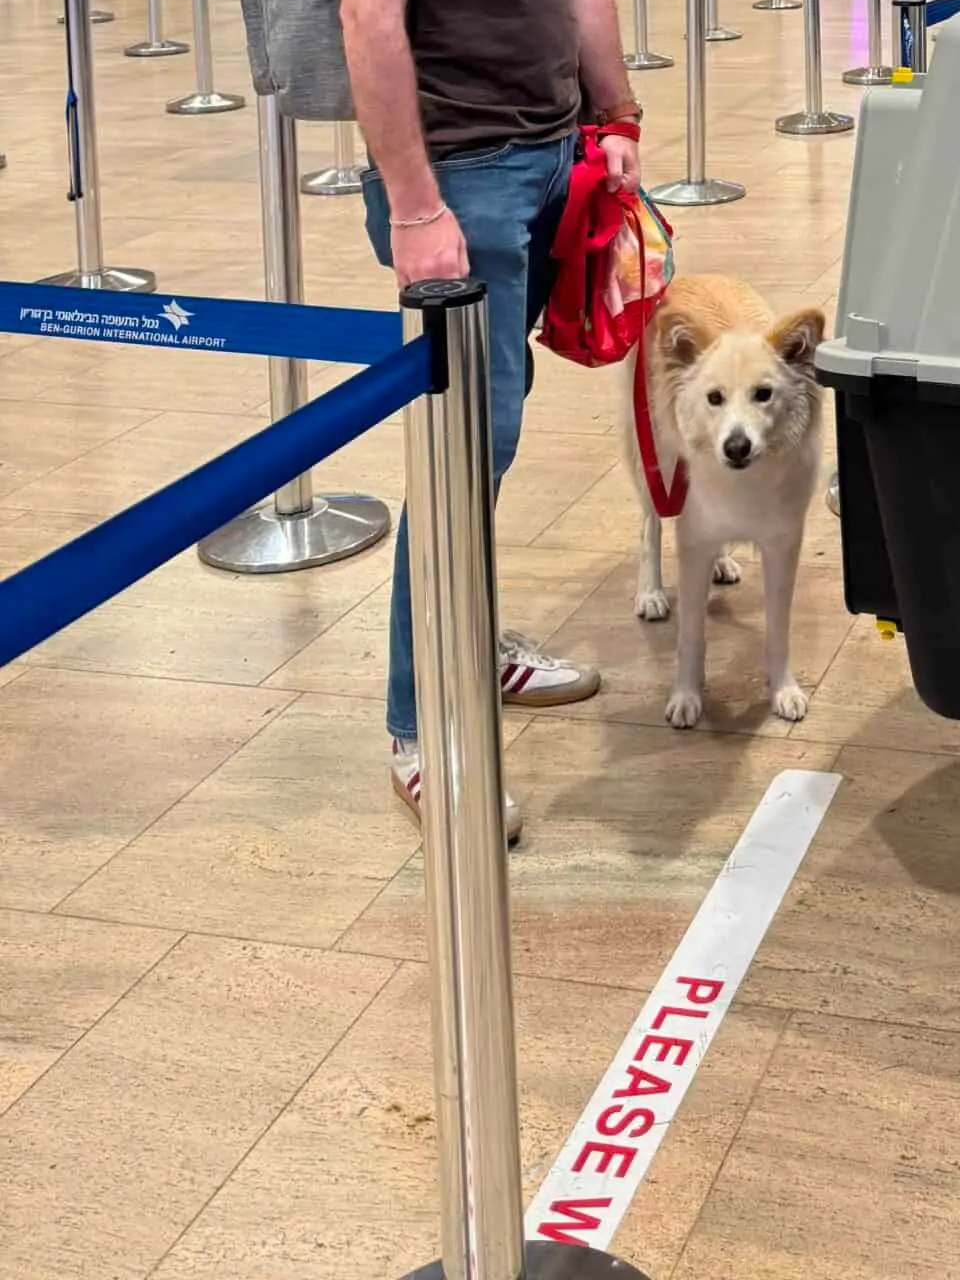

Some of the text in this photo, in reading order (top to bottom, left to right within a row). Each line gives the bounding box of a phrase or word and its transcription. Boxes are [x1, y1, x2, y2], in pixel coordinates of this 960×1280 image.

[40, 322, 227, 348] BEN-GURION INTERNATIONAL AIRPORT
[571, 975, 726, 1178] PLEASE
